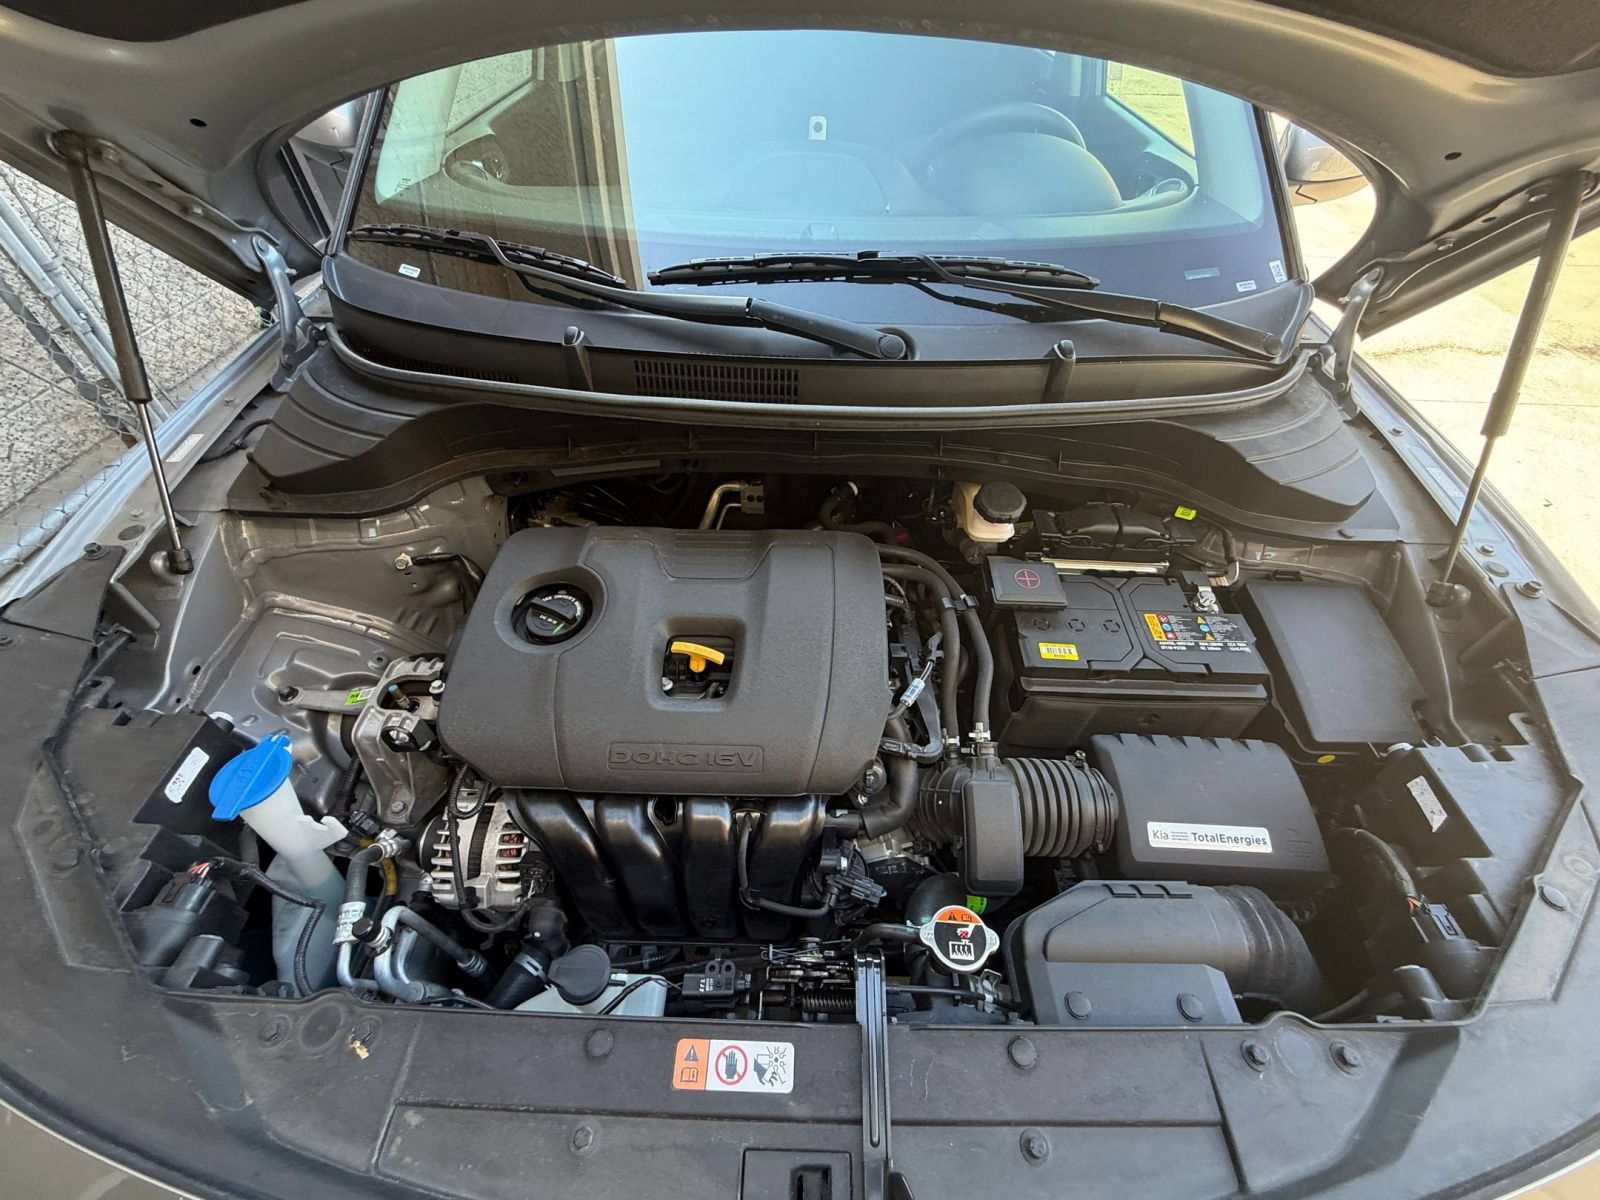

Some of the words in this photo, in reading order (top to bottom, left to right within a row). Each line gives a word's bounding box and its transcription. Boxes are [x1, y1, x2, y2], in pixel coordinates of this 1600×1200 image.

[609, 750, 699, 766] DOHC
[706, 751, 756, 767] 16V
[1152, 830, 1169, 841] Kia
[1191, 832, 1268, 847] TotalEnergies
